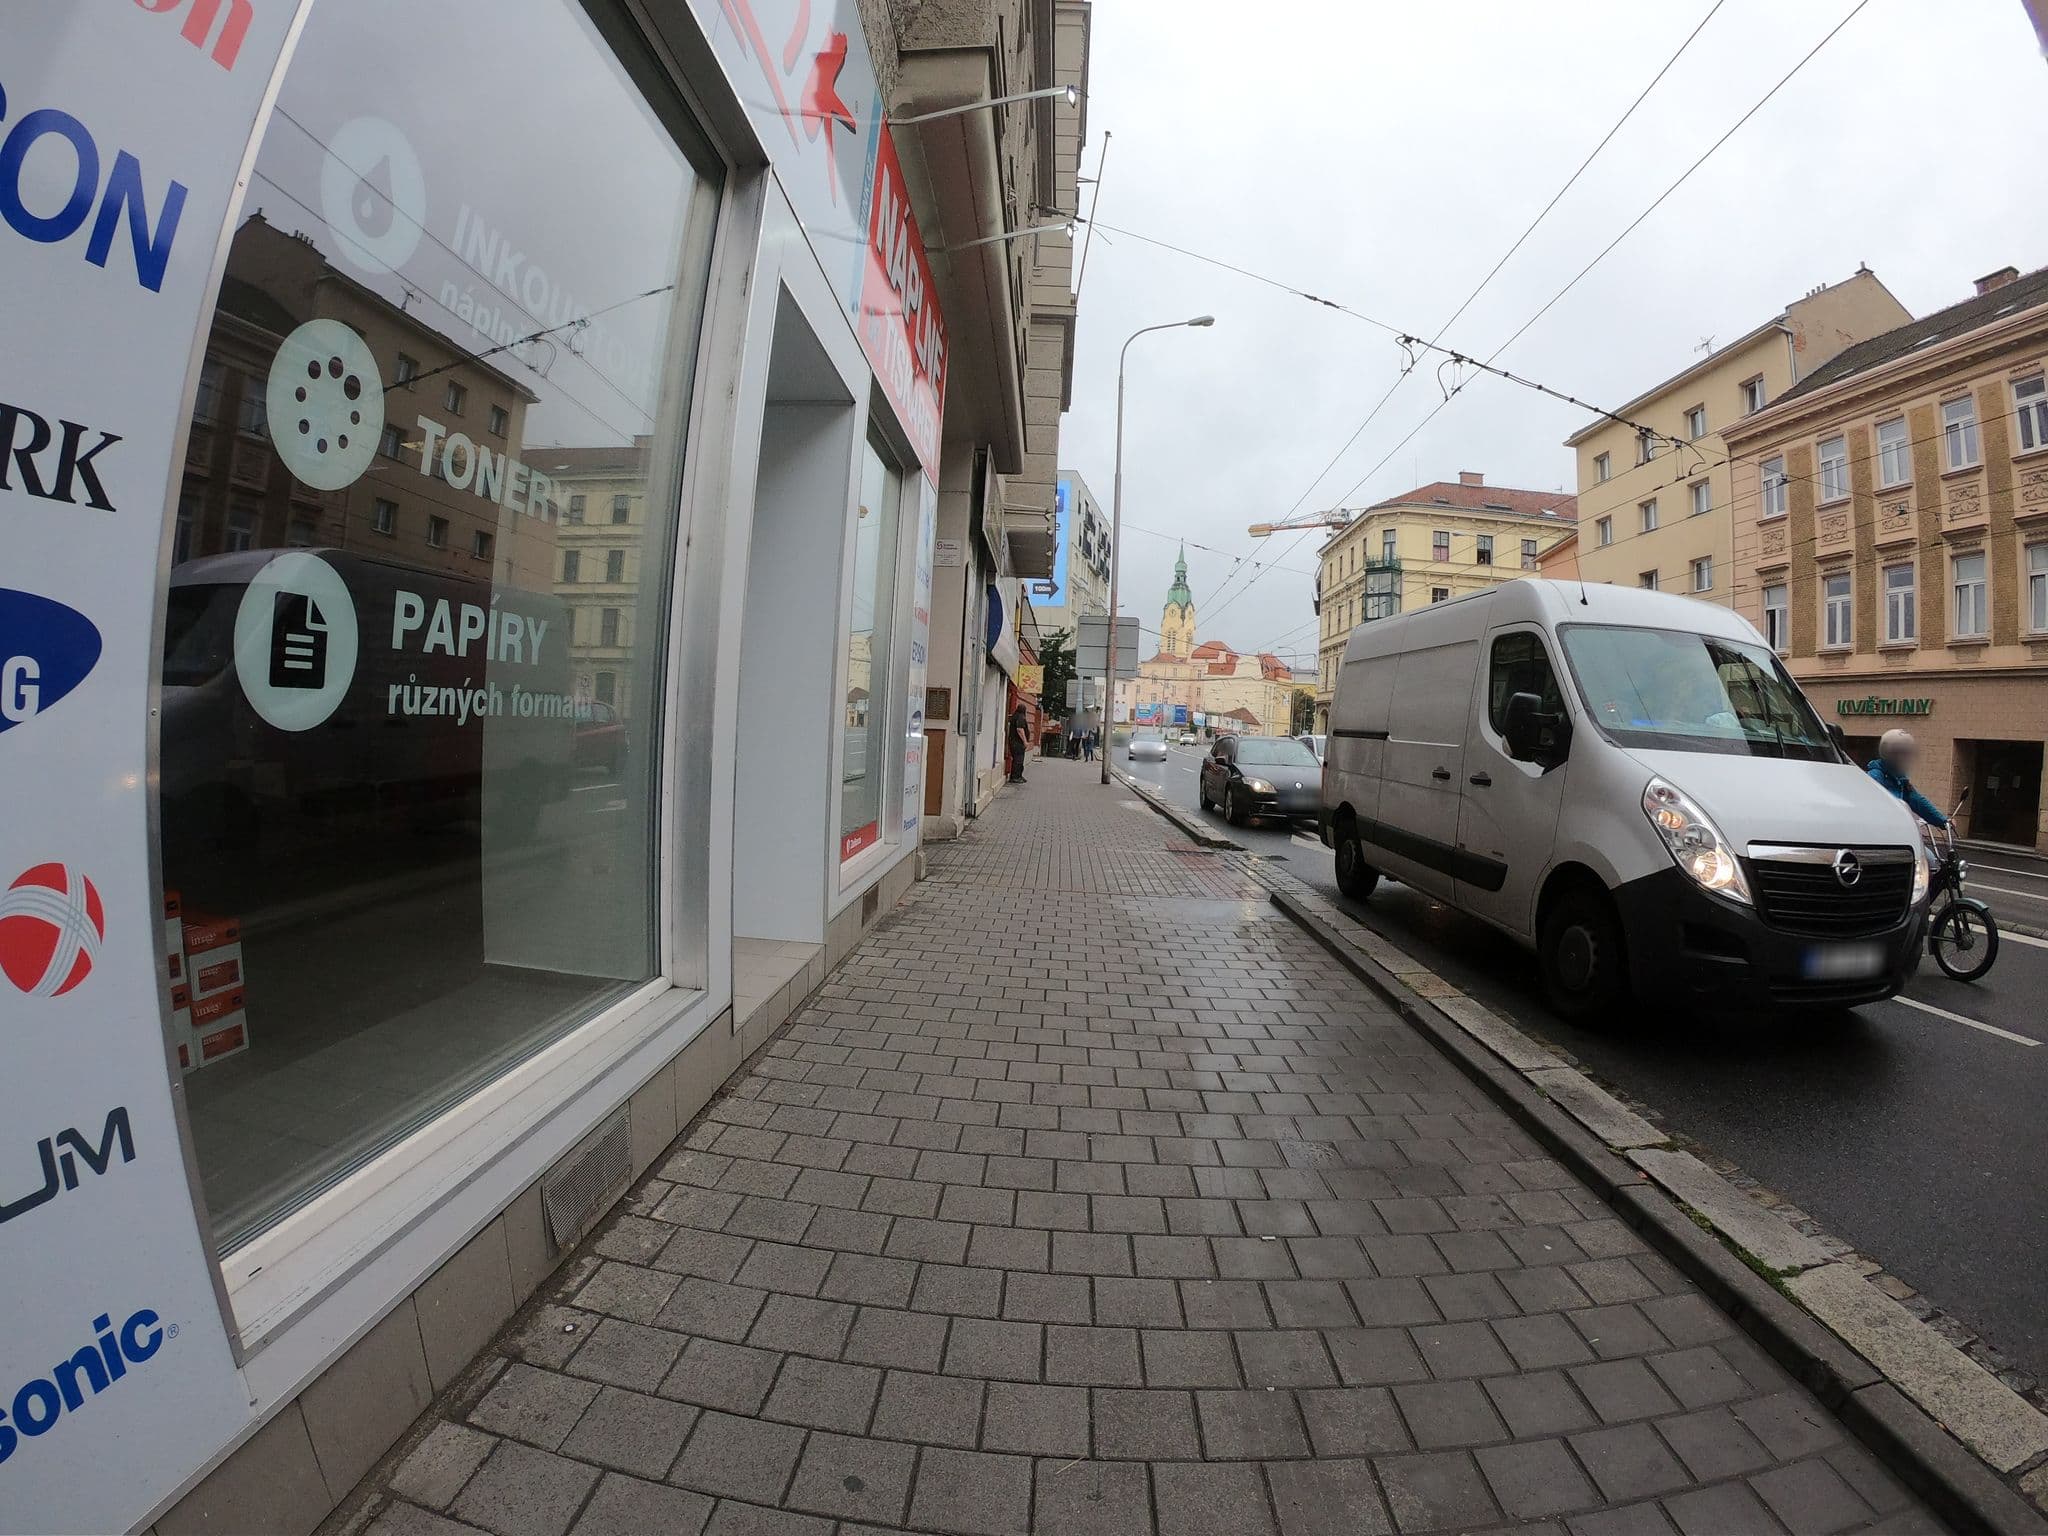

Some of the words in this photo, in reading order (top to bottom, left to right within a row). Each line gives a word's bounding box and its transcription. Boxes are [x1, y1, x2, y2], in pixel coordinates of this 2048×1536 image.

[0, 83, 188, 293] ON
[392, 590, 549, 666] PAPÍRY
[388, 673, 503, 727] různých
[1837, 695, 1932, 716] KVĚTINY
